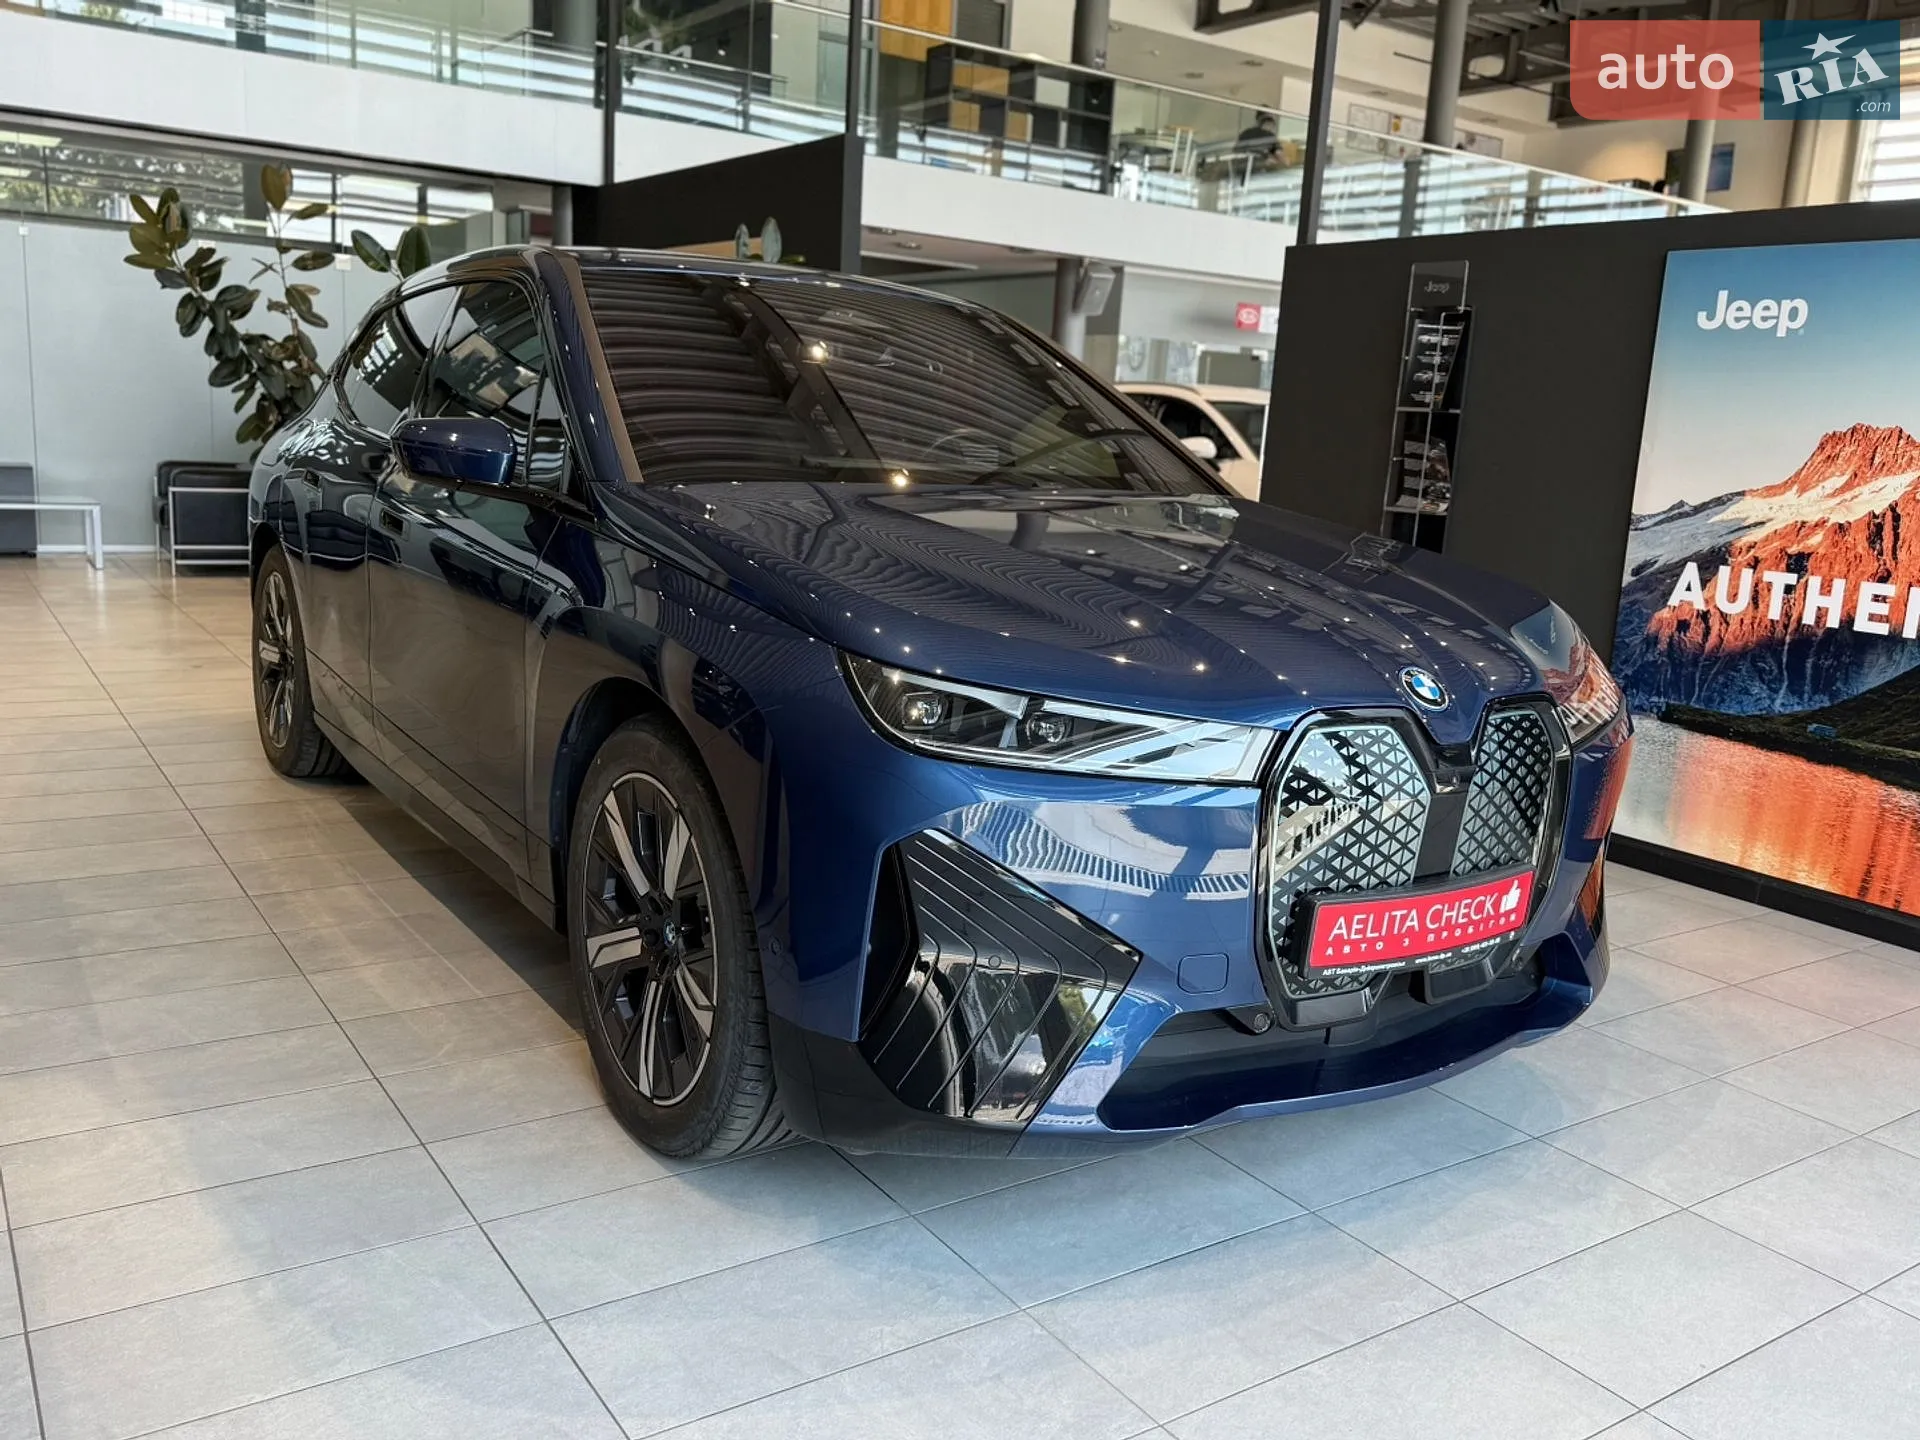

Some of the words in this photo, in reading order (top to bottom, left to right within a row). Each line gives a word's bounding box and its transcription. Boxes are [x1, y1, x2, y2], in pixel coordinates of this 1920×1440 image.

[1697, 290, 1808, 337] Jeep
[1328, 908, 1419, 942] AELITA
[1425, 892, 1499, 929] CHECK
[1325, 941, 1384, 956] АВТО
